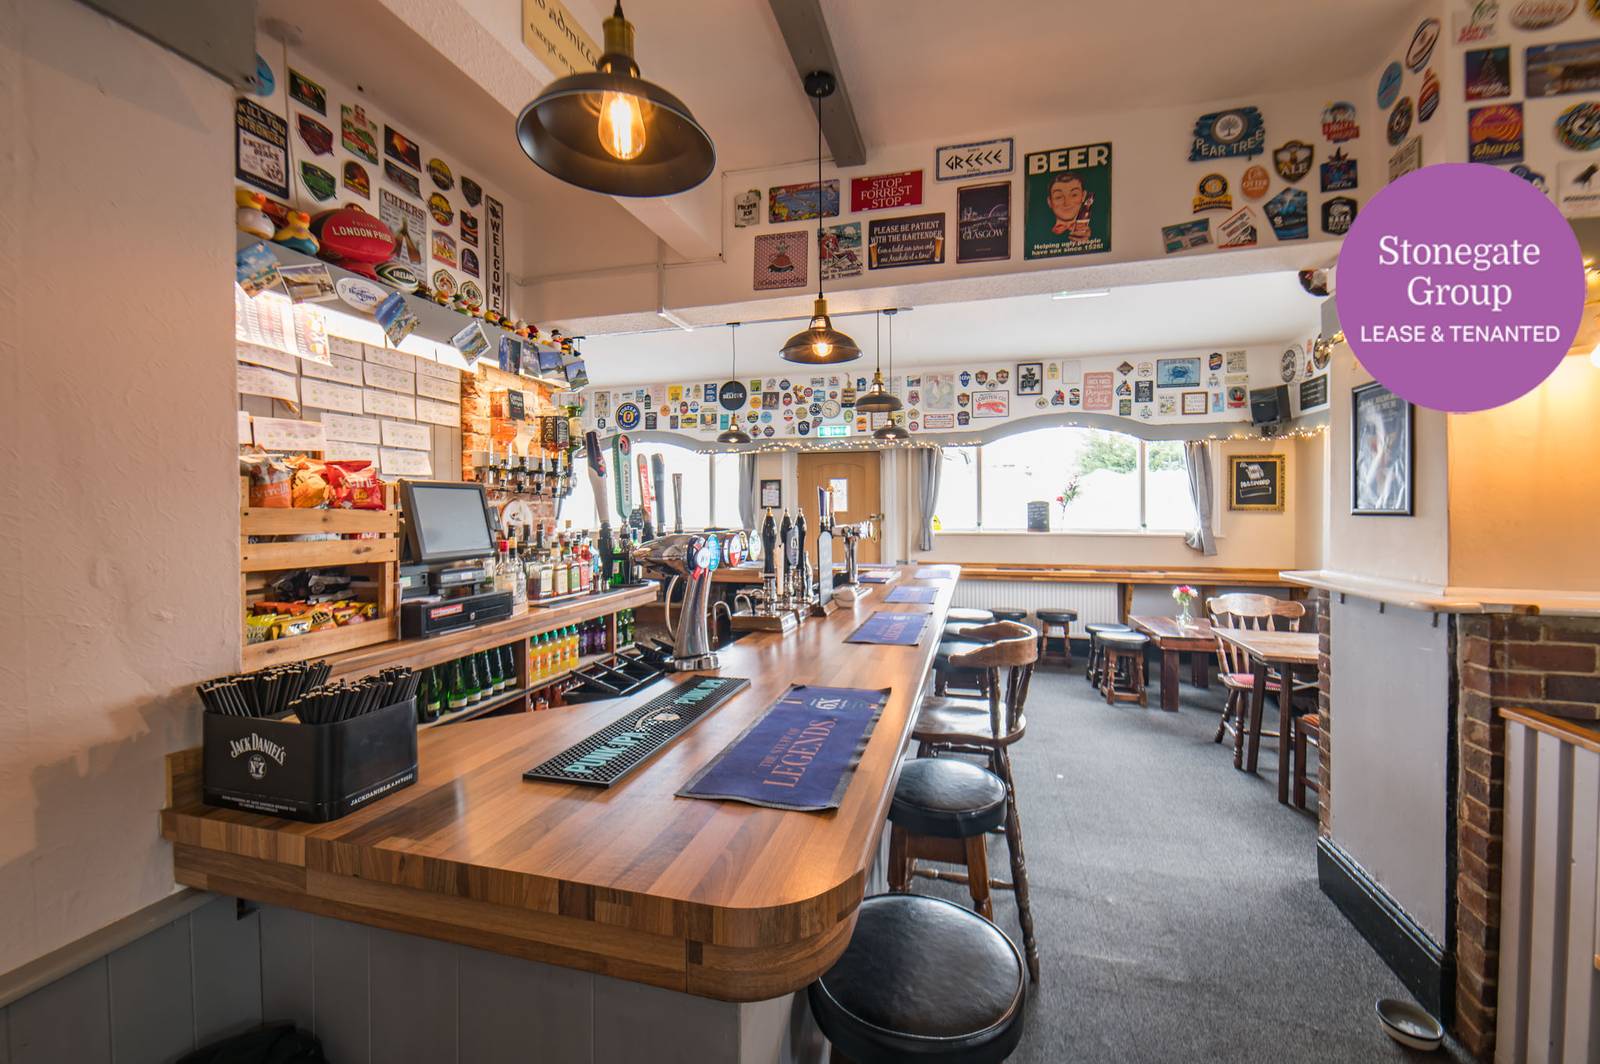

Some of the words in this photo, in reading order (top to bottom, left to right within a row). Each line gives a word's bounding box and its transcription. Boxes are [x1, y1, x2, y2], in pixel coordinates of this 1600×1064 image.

[1196, 137, 1226, 157] PEAR
[1231, 129, 1265, 153] TREE
[945, 149, 1003, 171] GREECE
[1028, 145, 1110, 176] BEER
[872, 177, 902, 190] STOP
[861, 185, 912, 201] FORREST
[383, 191, 426, 220] CHEERS
[871, 196, 902, 209] STOP
[332, 226, 373, 240] LONDON
[873, 224, 900, 235] PLEASE
[900, 223, 910, 232] BE
[910, 220, 940, 231] PATIENT
[962, 227, 1005, 241] GLASGOW
[887, 234, 901, 242] THE
[901, 230, 943, 242] BARTENDER
[1033, 242, 1060, 251] Helping
[1061, 240, 1076, 250] ugly
[490, 218, 501, 311] WELCOME
[230, 736, 252, 758] JACK
[563, 745, 627, 774] PUNK
[607, 731, 650, 747] IPA
